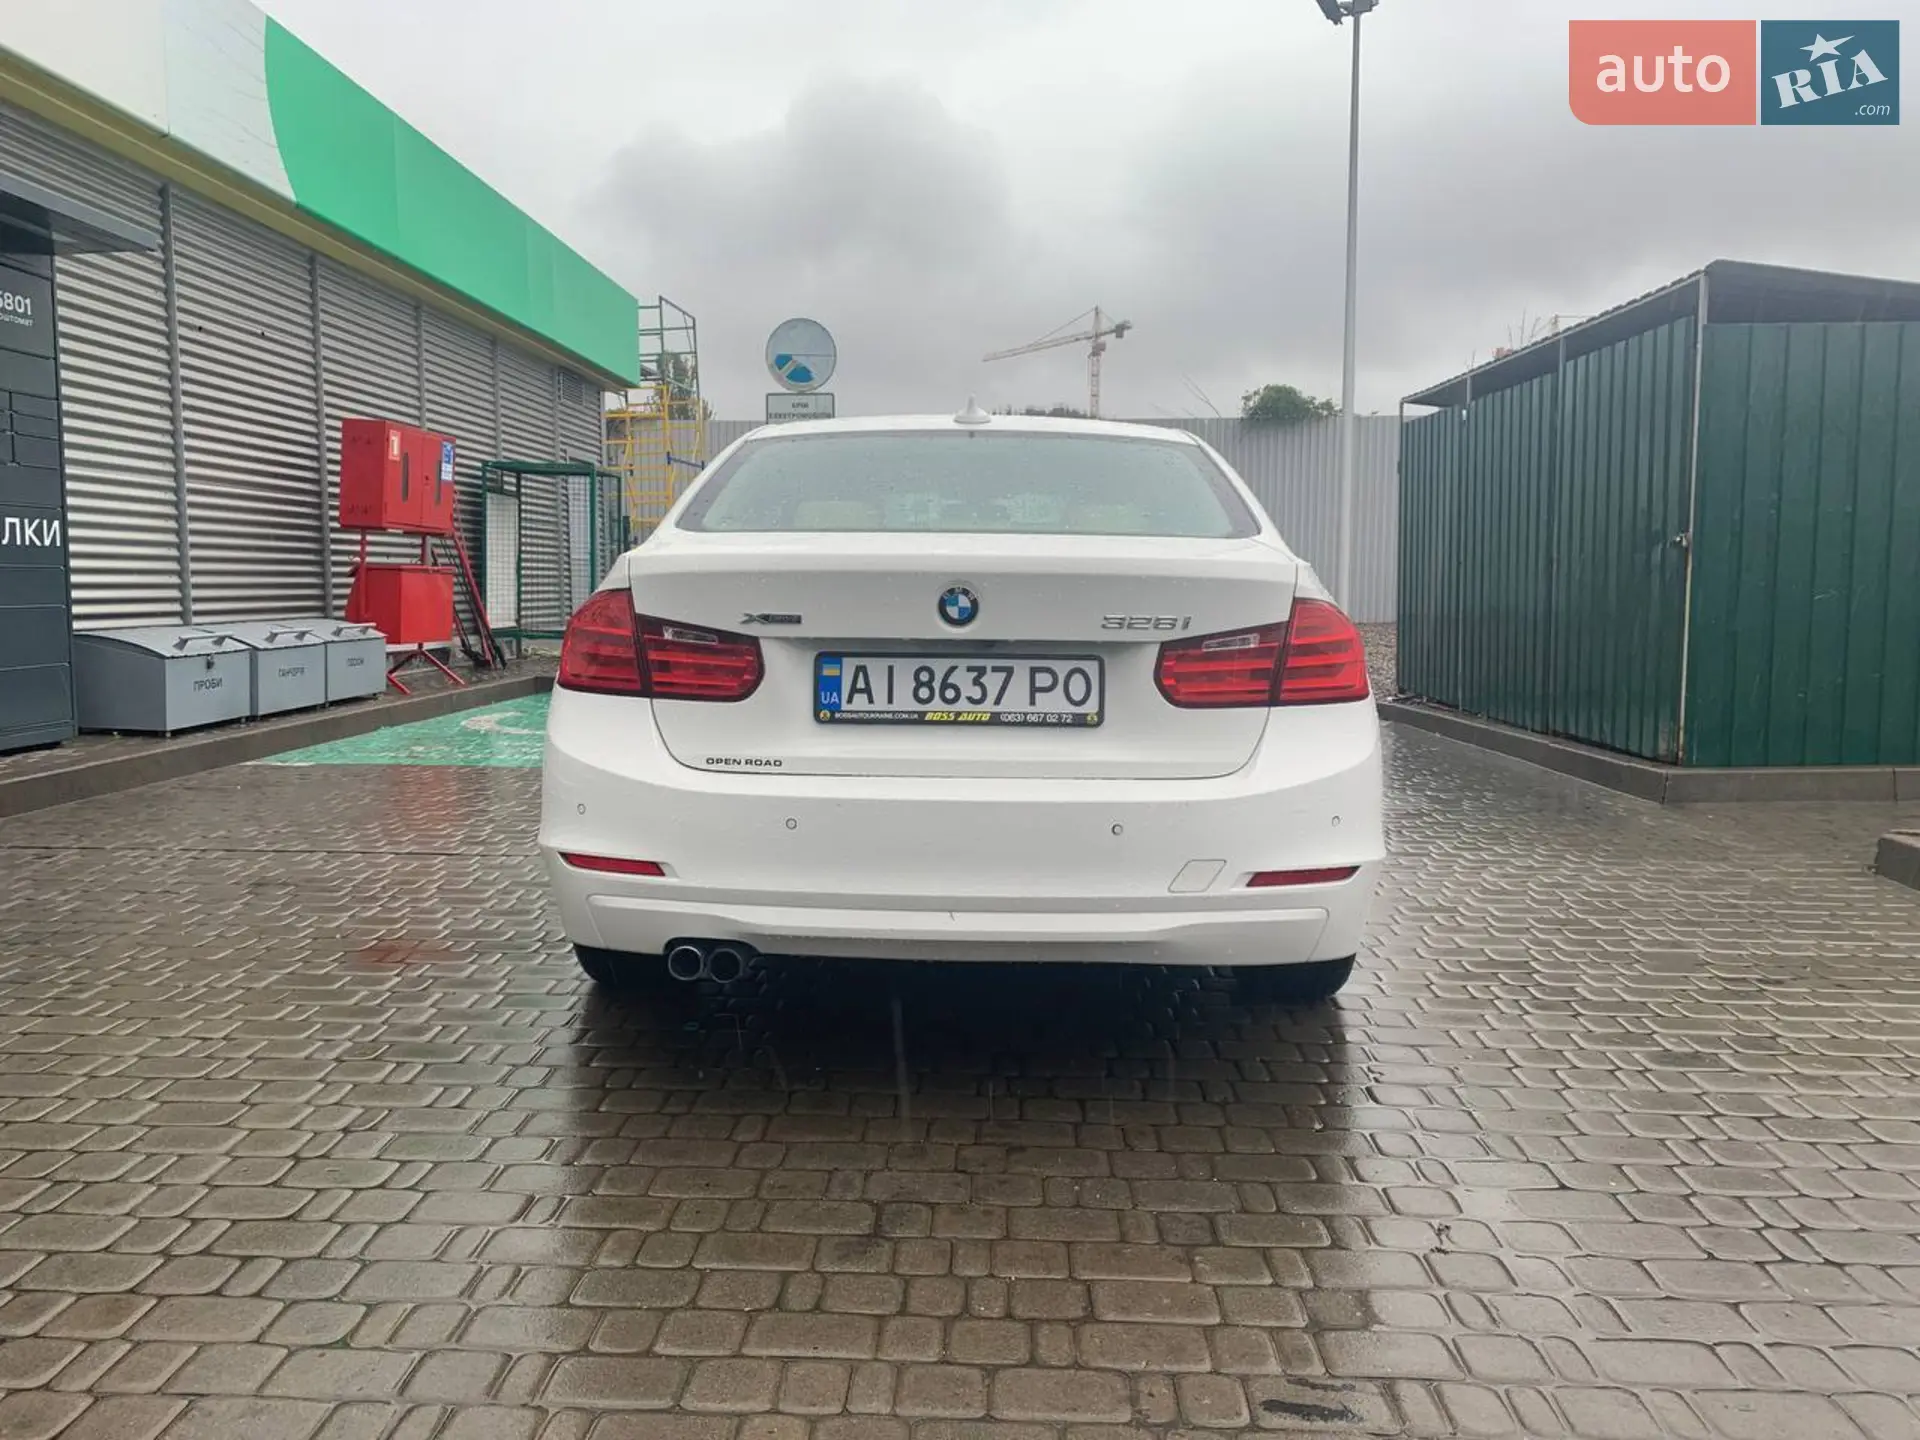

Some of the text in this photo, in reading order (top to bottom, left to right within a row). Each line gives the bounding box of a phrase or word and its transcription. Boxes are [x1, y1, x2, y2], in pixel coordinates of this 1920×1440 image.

[1, 516, 61, 547] ЛКИ
[193, 677, 223, 691] ПРОБИ
[846, 664, 1092, 707] AI 8637 PO
[821, 691, 839, 704] UA
[924, 712, 954, 721] BOSS
[958, 712, 991, 721] AUTO
[1061, 713, 1073, 723] 72
[706, 757, 742, 766] OPEN
